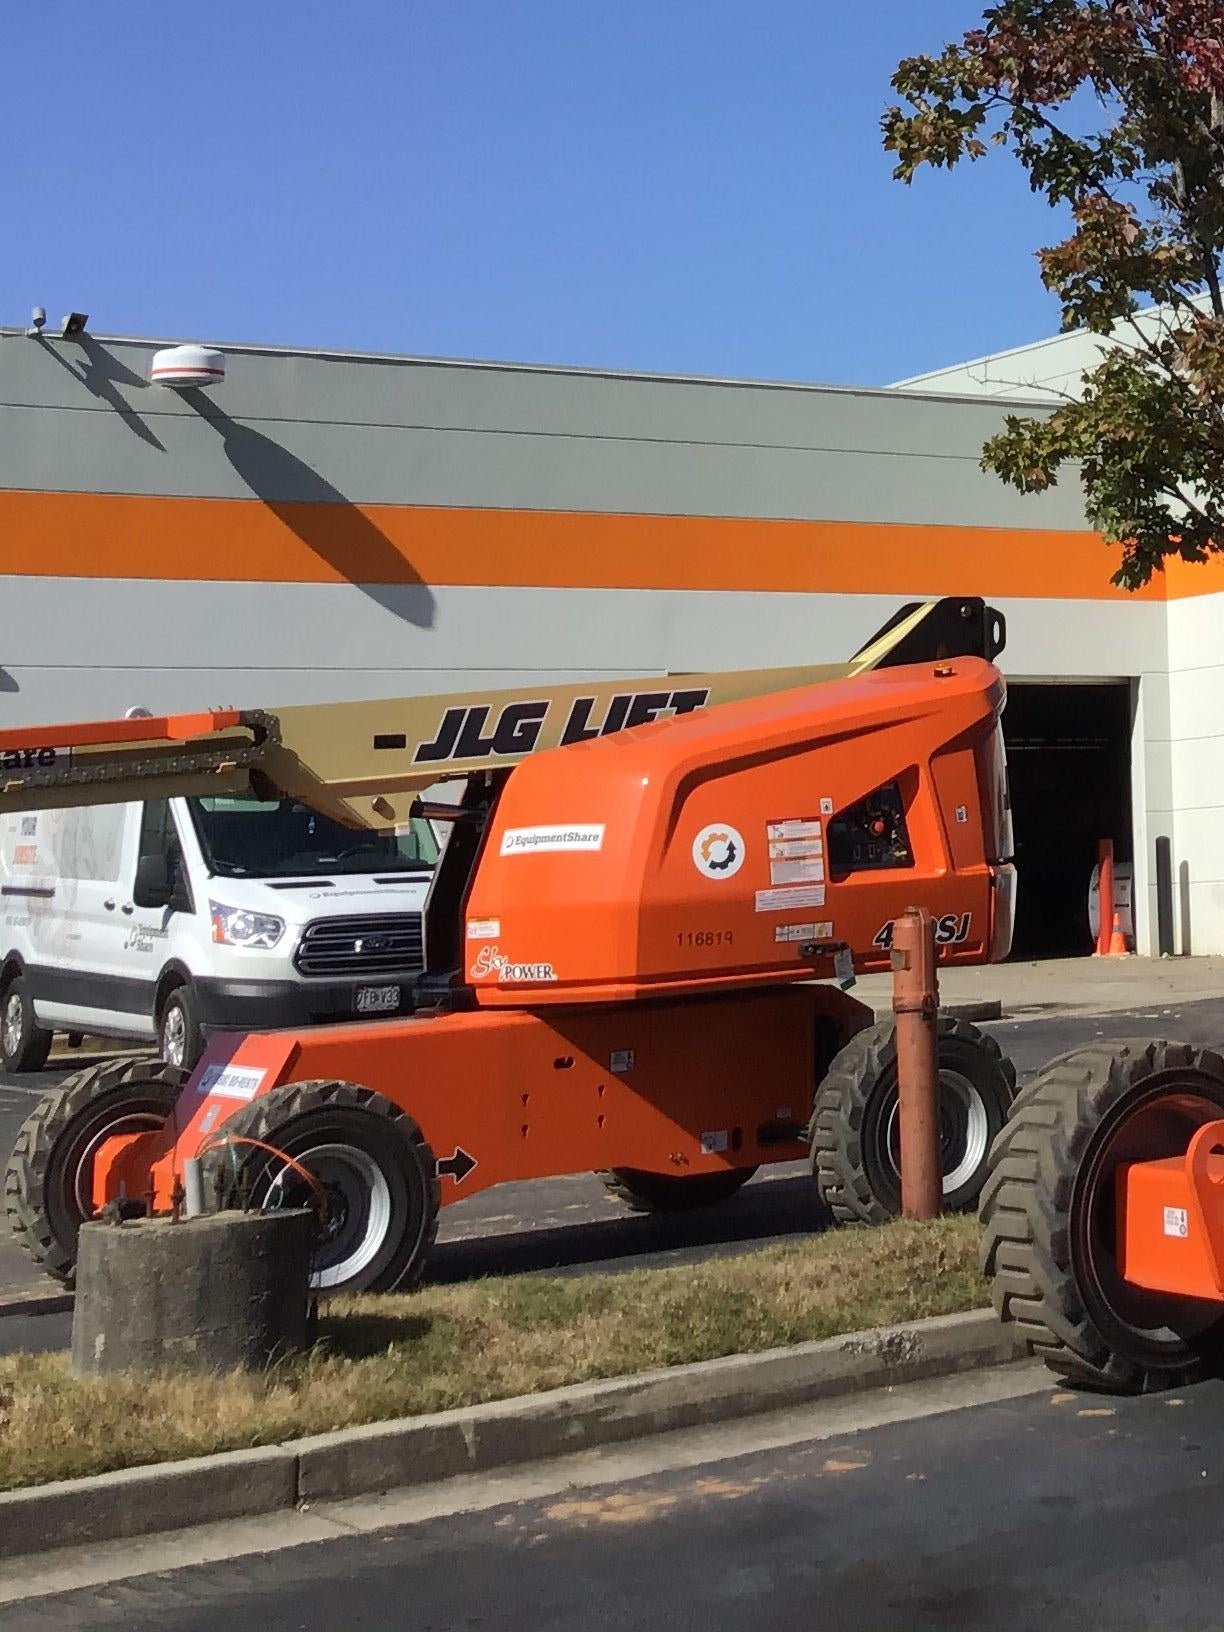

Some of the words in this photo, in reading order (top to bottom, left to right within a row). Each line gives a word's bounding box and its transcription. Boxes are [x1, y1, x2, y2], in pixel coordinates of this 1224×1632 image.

[411, 699, 552, 766] JLG
[515, 831, 600, 848] EquipmentShare
[677, 930, 733, 947] 116819
[872, 912, 972, 950] 4SJ
[471, 946, 508, 980] Sky
[503, 964, 554, 981] POWER
